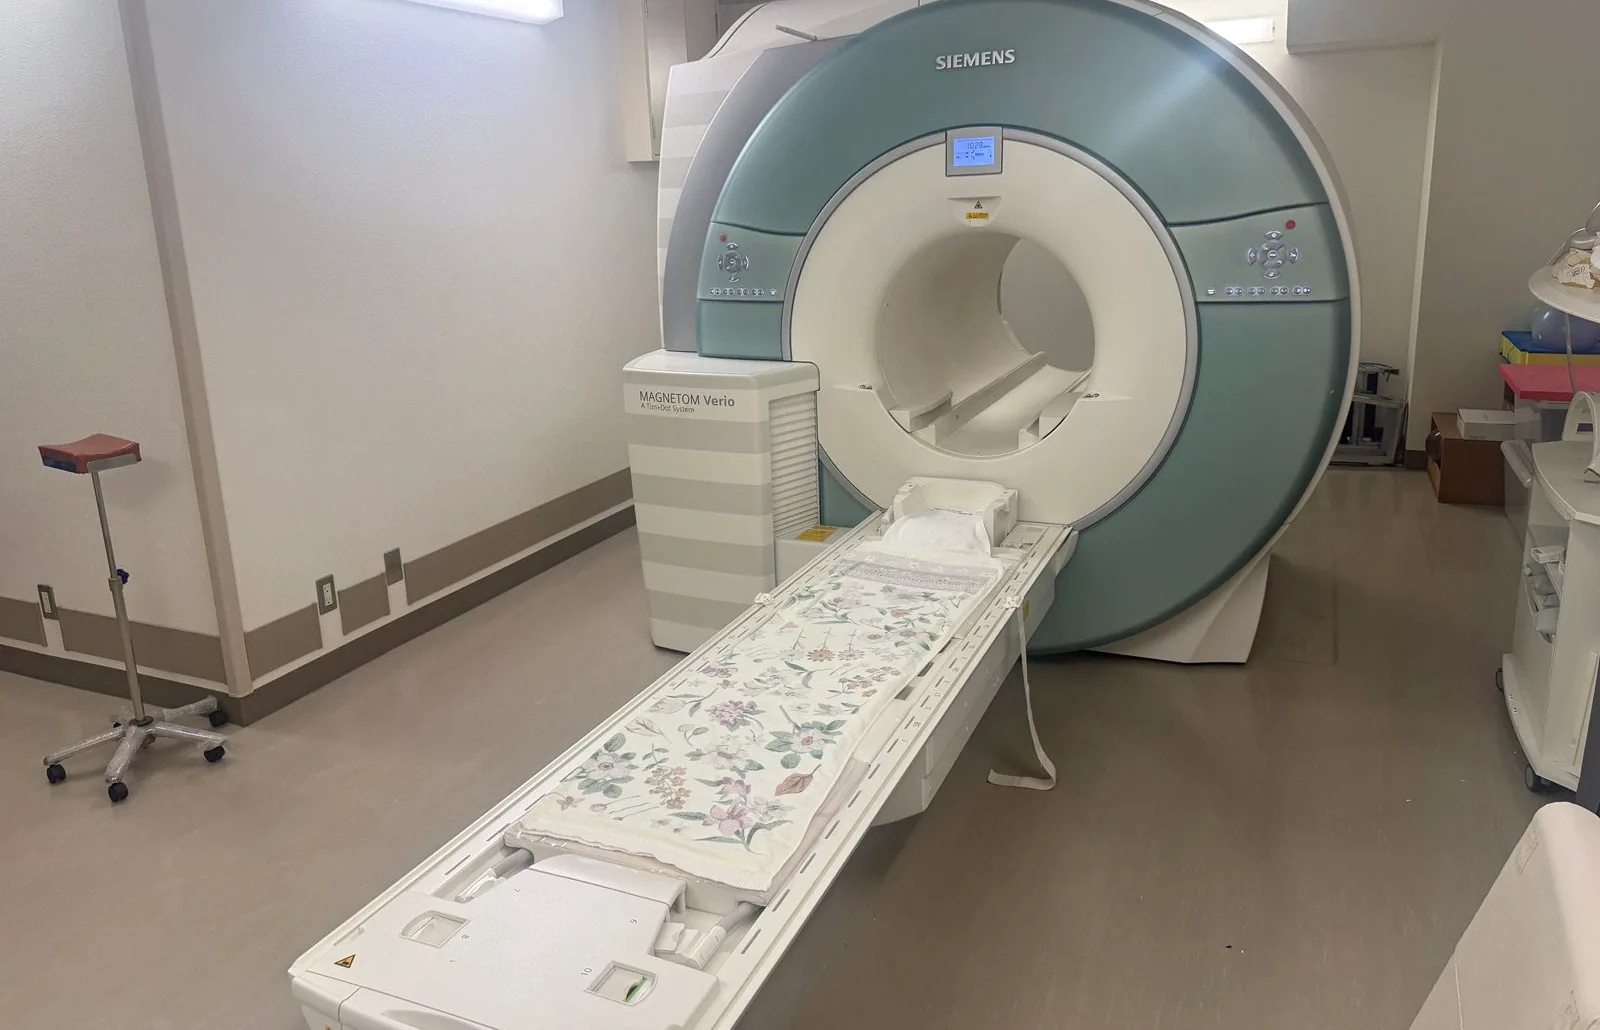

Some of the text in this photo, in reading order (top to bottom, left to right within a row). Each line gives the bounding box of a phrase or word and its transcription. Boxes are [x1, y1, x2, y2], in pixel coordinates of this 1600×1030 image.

[935, 49, 1015, 70] SIEMENS
[639, 391, 735, 407] MAGNETOM Verio
[672, 405, 695, 414] System
[580, 967, 593, 976] 10
